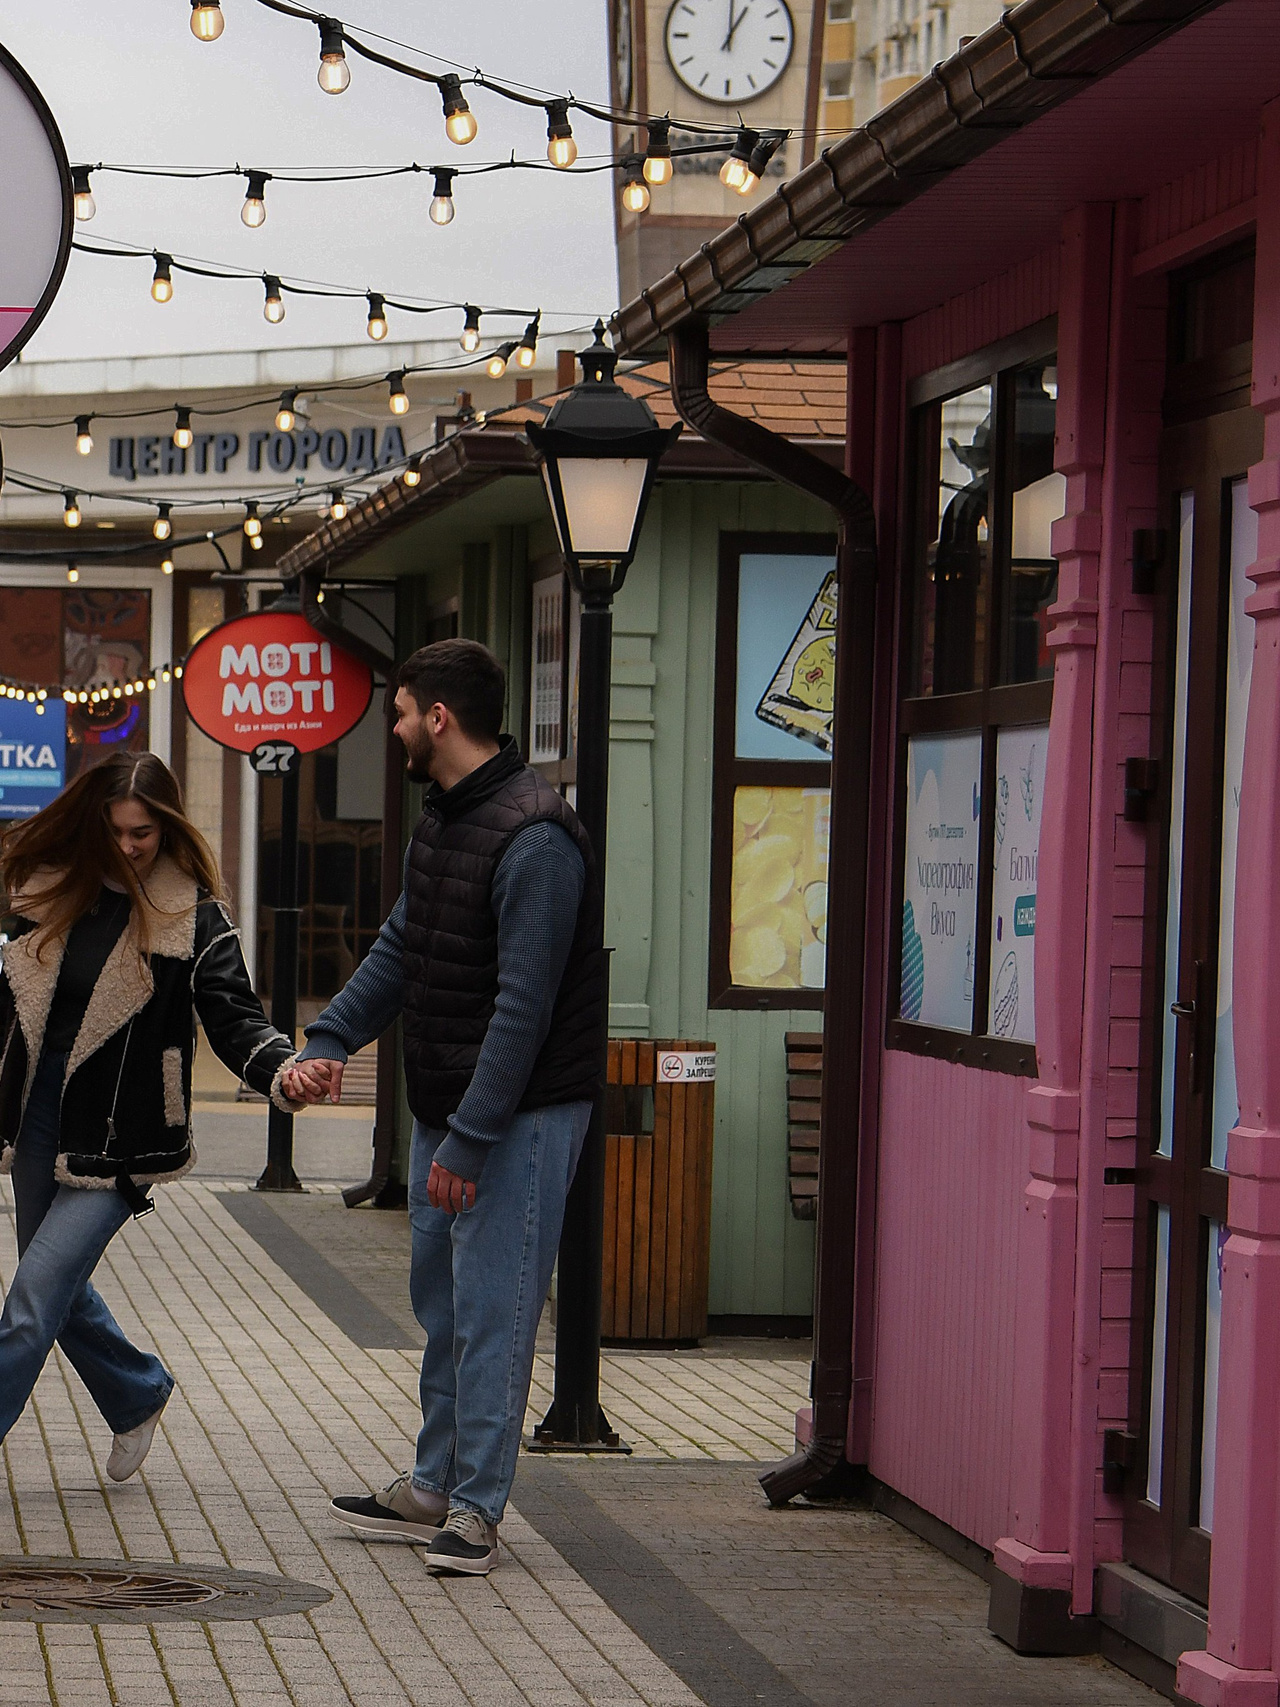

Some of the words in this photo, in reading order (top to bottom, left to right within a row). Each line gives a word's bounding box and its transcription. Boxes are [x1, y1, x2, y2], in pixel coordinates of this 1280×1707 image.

[109, 431, 239, 481] ЦЕНТР
[247, 425, 407, 474] ГОРОДА
[219, 641, 332, 679] MOTI
[221, 679, 335, 717] MOTI
[255, 744, 295, 772] 27
